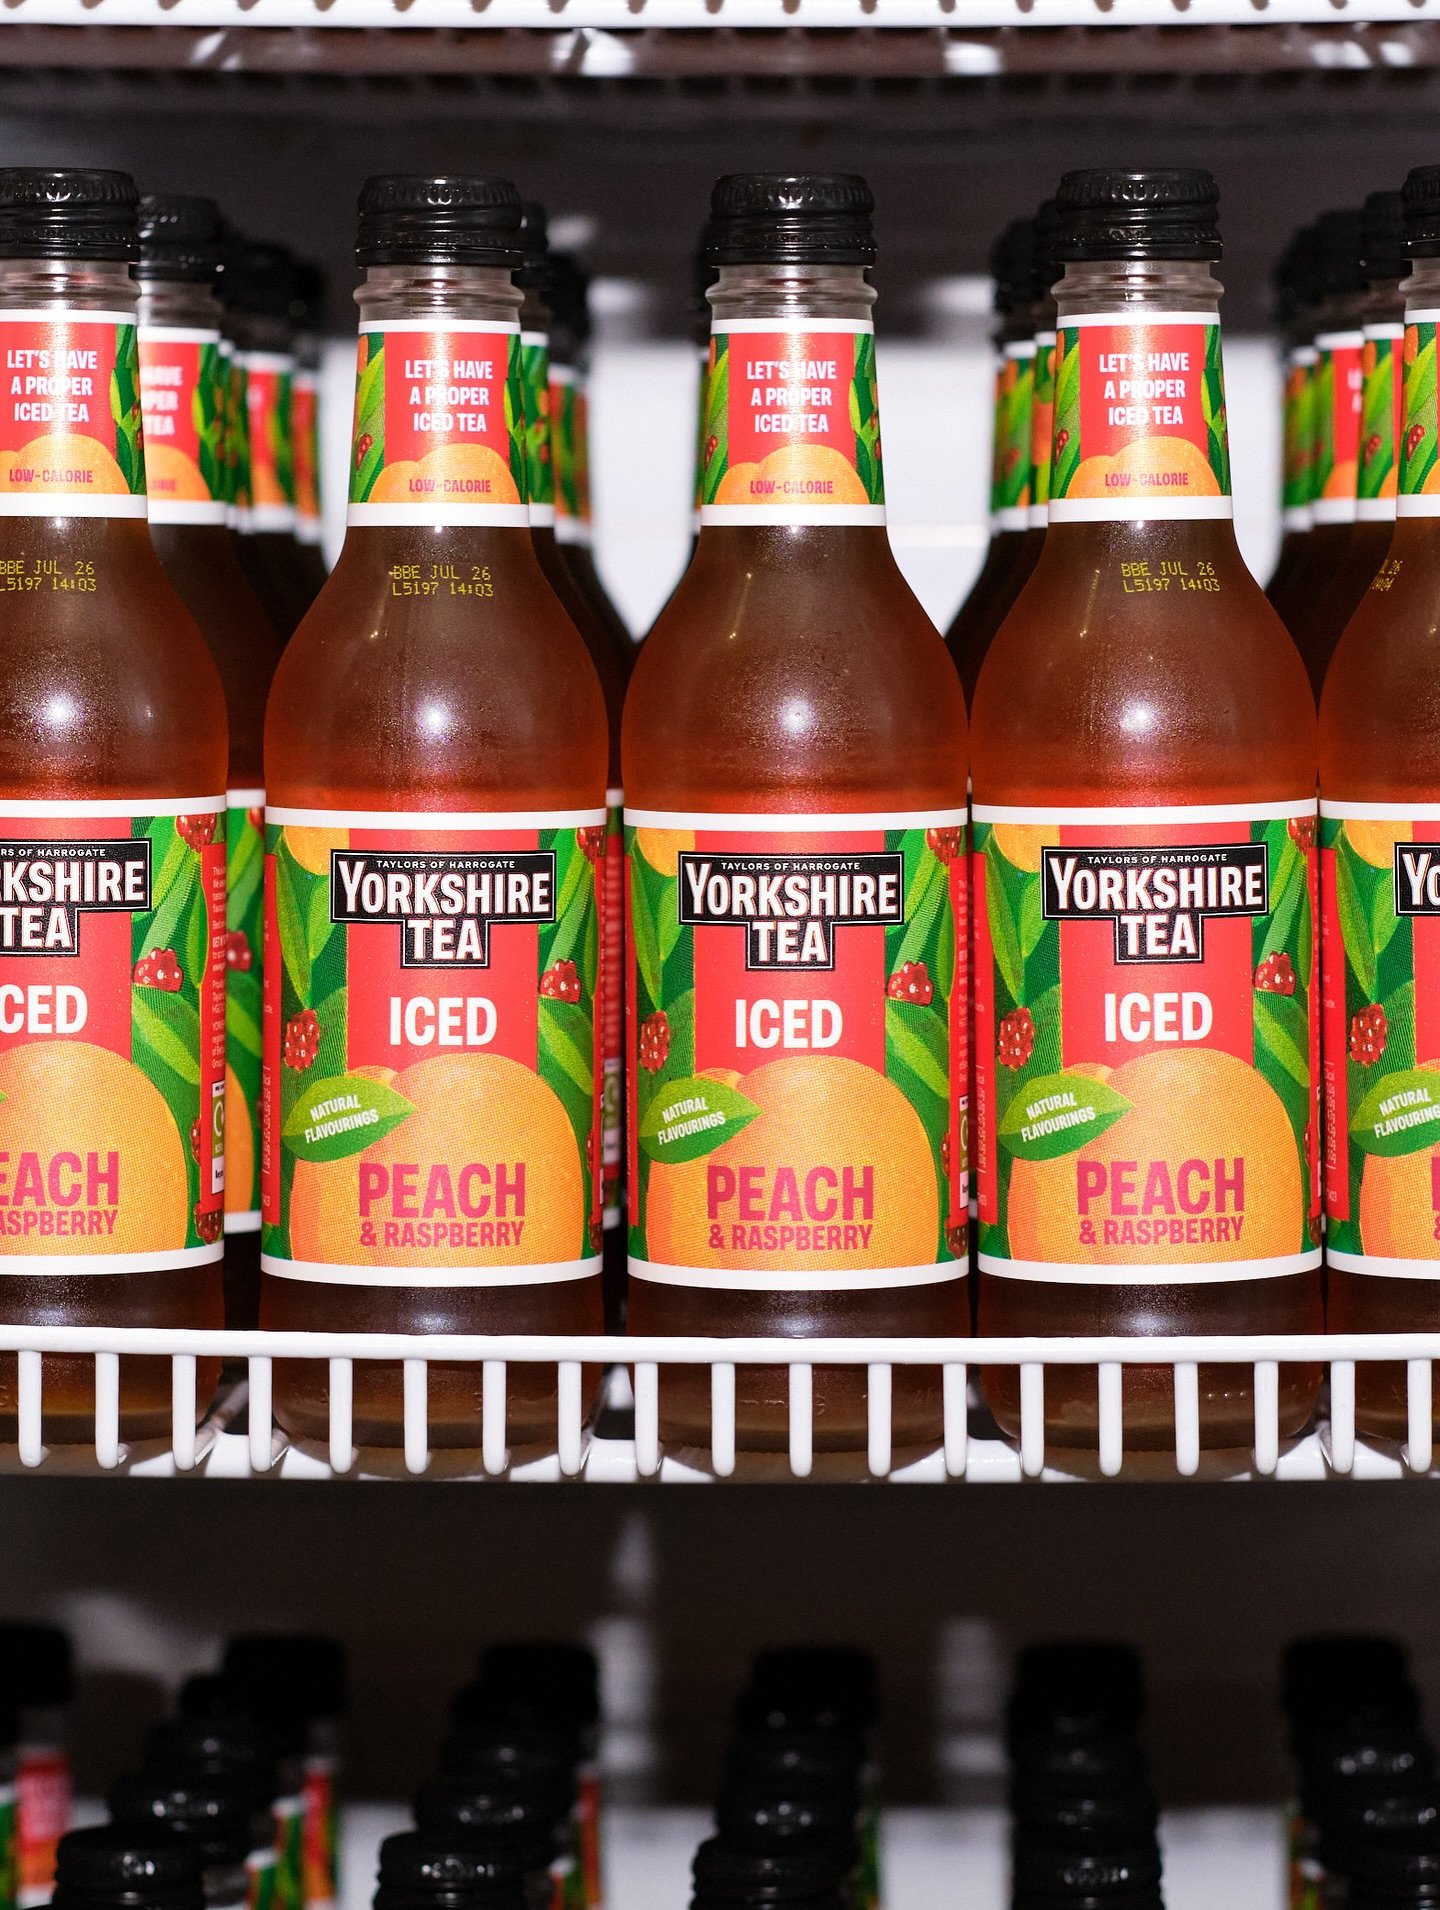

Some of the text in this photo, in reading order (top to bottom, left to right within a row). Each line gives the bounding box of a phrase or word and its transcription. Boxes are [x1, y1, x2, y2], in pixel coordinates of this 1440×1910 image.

[7, 350, 97, 370] LET'S HAVE
[405, 360, 493, 379] LET'S HAVE
[747, 361, 836, 380] LET'S HAVE
[1099, 353, 1189, 373] LET'S HAVE
[10, 377, 92, 396] A PROPER
[409, 387, 489, 406] A PROPER
[751, 387, 832, 406] A PROPER
[1104, 379, 1186, 399] A PROPER
[14, 403, 89, 422] ICED TEA
[414, 413, 487, 432] ICED TEA
[755, 414, 829, 433] ICED TEA
[1108, 406, 1184, 425] ICED TEA
[9, 469, 93, 483] LOW-CALORIE
[409, 479, 491, 493] LOW-CALORIE
[750, 480, 834, 494] LOW-CALORIE
[1104, 473, 1189, 487] LOW-CALORIE
[33, 560, 62, 575] JUL
[75, 561, 95, 575] 26
[393, 565, 491, 581] BBE JUL 26
[1121, 562, 1215, 577] BBE JUL 26
[0, 577, 97, 592] 5197 14:03
[392, 582, 494, 597] L5197 14:03
[1123, 578, 1220, 593] L5197 14:03
[18, 848, 34, 857] OF
[37, 848, 106, 857] HARROGATE
[376, 860, 515, 869] TAYLORS OF HARROGATE
[1088, 854, 1227, 864] TAYLORS OF HARROGATE
[721, 862, 860, 871] TAYLORS OF HARROGATE
[0, 861, 146, 903] KSHIRE
[338, 860, 551, 914] YORKSHIRE
[685, 862, 898, 916] YORKSHIRE
[1049, 857, 1263, 911] YORKSHIRE
[0, 906, 74, 948] TEA
[407, 919, 484, 961] TEA
[1120, 914, 1199, 956] TEA
[752, 921, 829, 962] TEA
[0, 984, 88, 1034] CED
[390, 997, 497, 1046] ICED
[1105, 992, 1213, 1042] ICED
[736, 999, 843, 1048] ICED
[310, 1094, 361, 1122] NATURAL
[662, 1097, 709, 1124] NATURAL
[1026, 1091, 1078, 1121] NATURAL
[1378, 1088, 1431, 1117] NATURAL
[304, 1108, 380, 1144] FLAVOURINGS
[657, 1111, 726, 1146] FLAVOURINGS
[1020, 1106, 1096, 1143] FLAVOURINGS
[1374, 1104, 1440, 1138] FLAVOURING
[0, 1152, 119, 1207] ACH
[359, 1163, 526, 1219] PEACH
[1077, 1157, 1245, 1216] PEACH
[707, 1166, 874, 1222] PEACH
[0, 1209, 118, 1236] SPBERRY
[360, 1221, 525, 1248] & RASPBERRY
[1079, 1216, 1244, 1246] & RASPBERRY
[708, 1224, 874, 1250] & RASPBERRY
